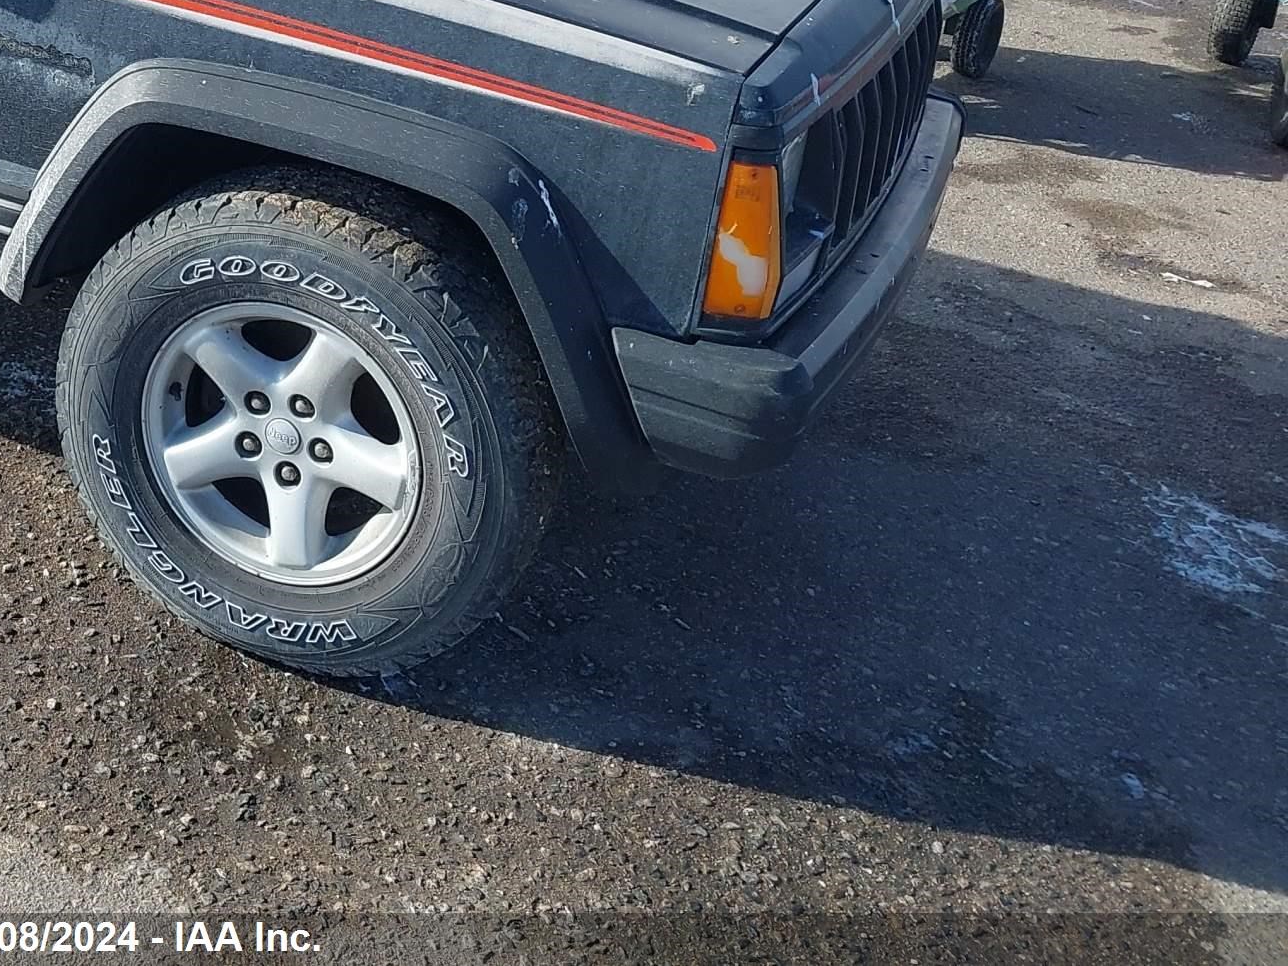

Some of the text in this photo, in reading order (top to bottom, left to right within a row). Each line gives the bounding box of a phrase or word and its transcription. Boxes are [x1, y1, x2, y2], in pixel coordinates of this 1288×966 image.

[179, 255, 469, 478] GOODYEAR
[267, 427, 298, 451] Jeep
[92, 433, 359, 644] WRANGLER
